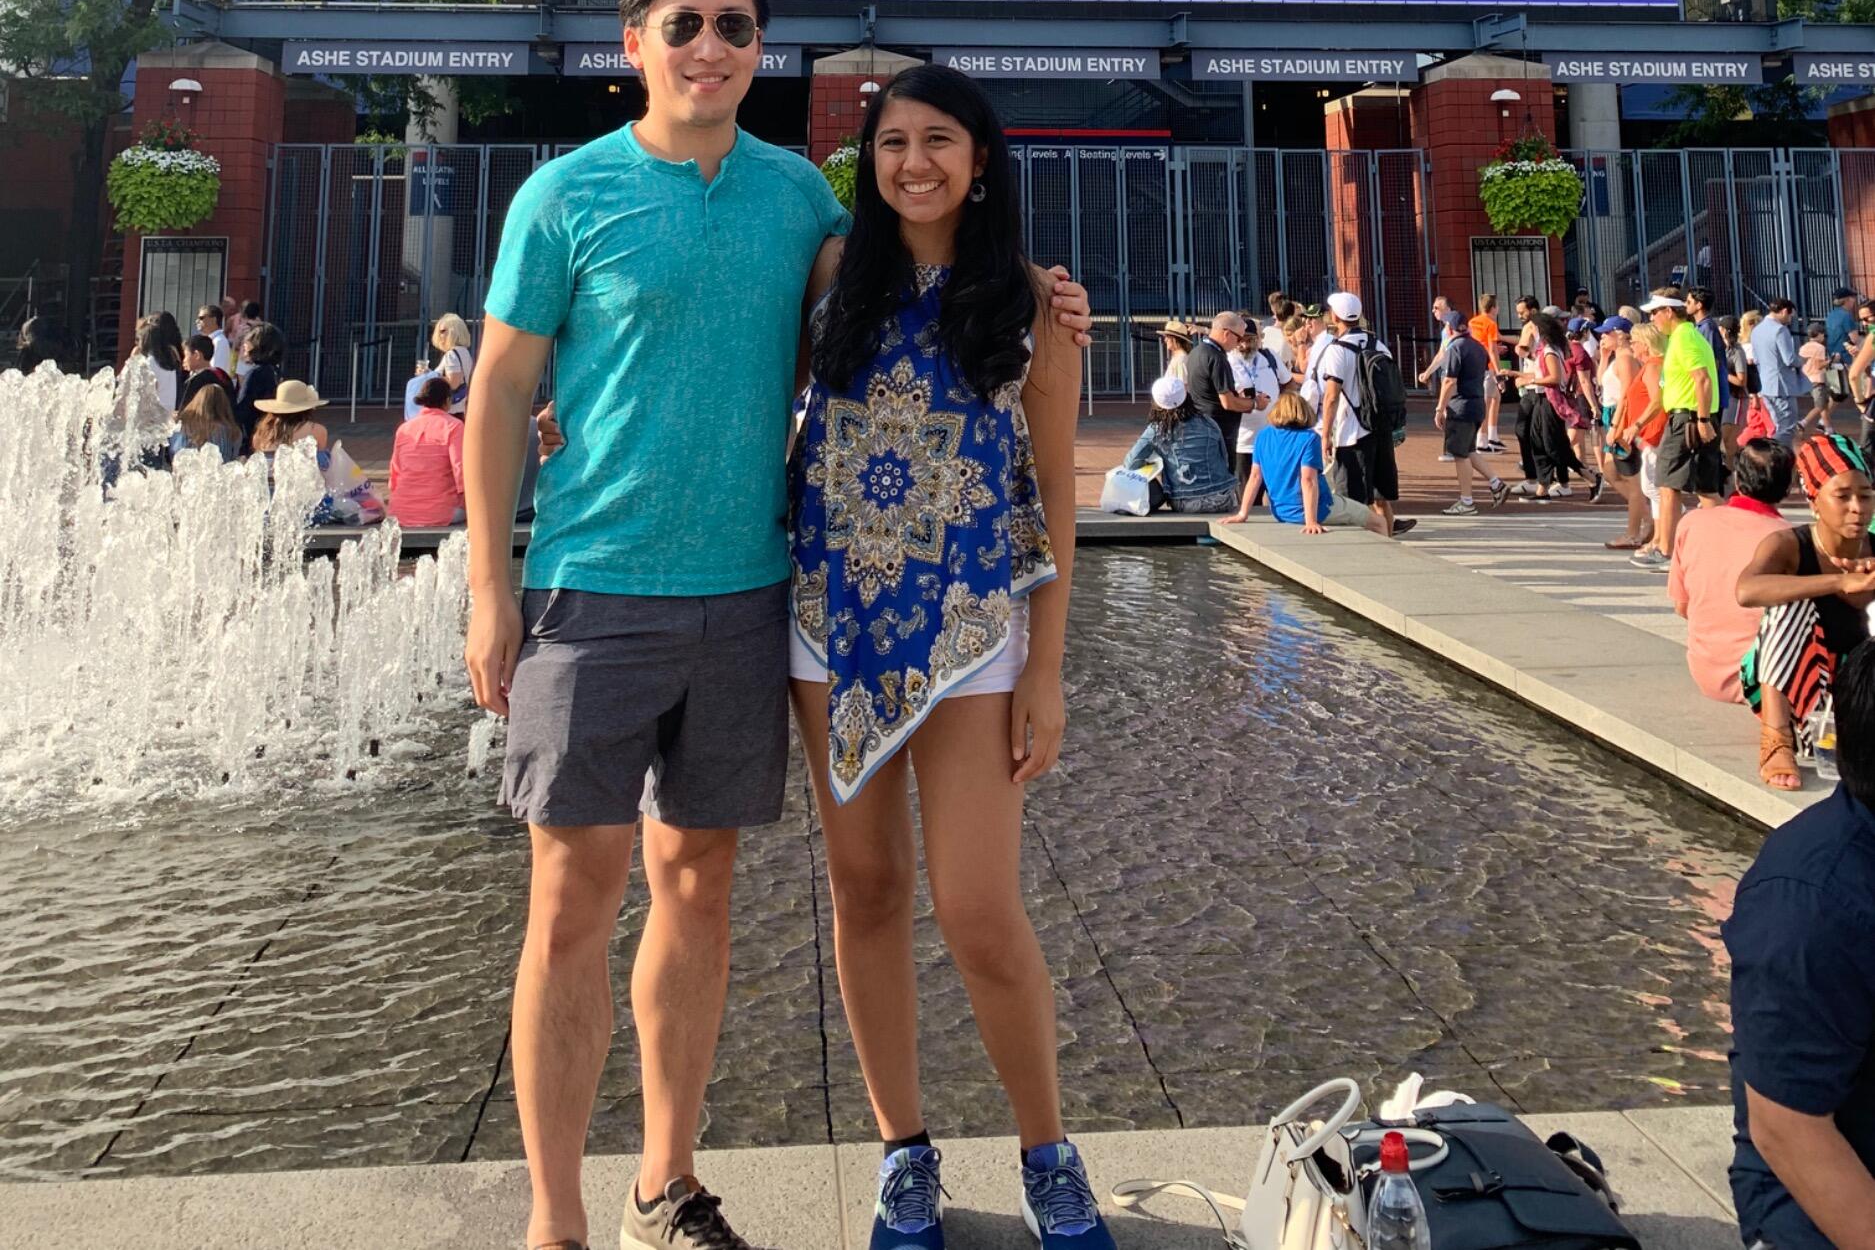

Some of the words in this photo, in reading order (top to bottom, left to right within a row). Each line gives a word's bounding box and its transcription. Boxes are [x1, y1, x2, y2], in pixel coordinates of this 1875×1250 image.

[297, 51, 350, 66] ASHE
[356, 51, 443, 67] STADIUM
[449, 52, 513, 67] ENTRY
[579, 54, 629, 68] ASHE
[948, 56, 996, 71] ASHE
[1001, 56, 1081, 72] STADIUM
[1087, 57, 1146, 72] ENTRY
[1207, 59, 1255, 73] ASHE
[1260, 59, 1339, 74] STADIUM
[1345, 60, 1404, 74] ENTRY
[1557, 62, 1604, 76] ASHE
[1609, 62, 1686, 77] STADIUM
[1692, 62, 1748, 77] ENTRY
[1808, 62, 1854, 78] ASHE
